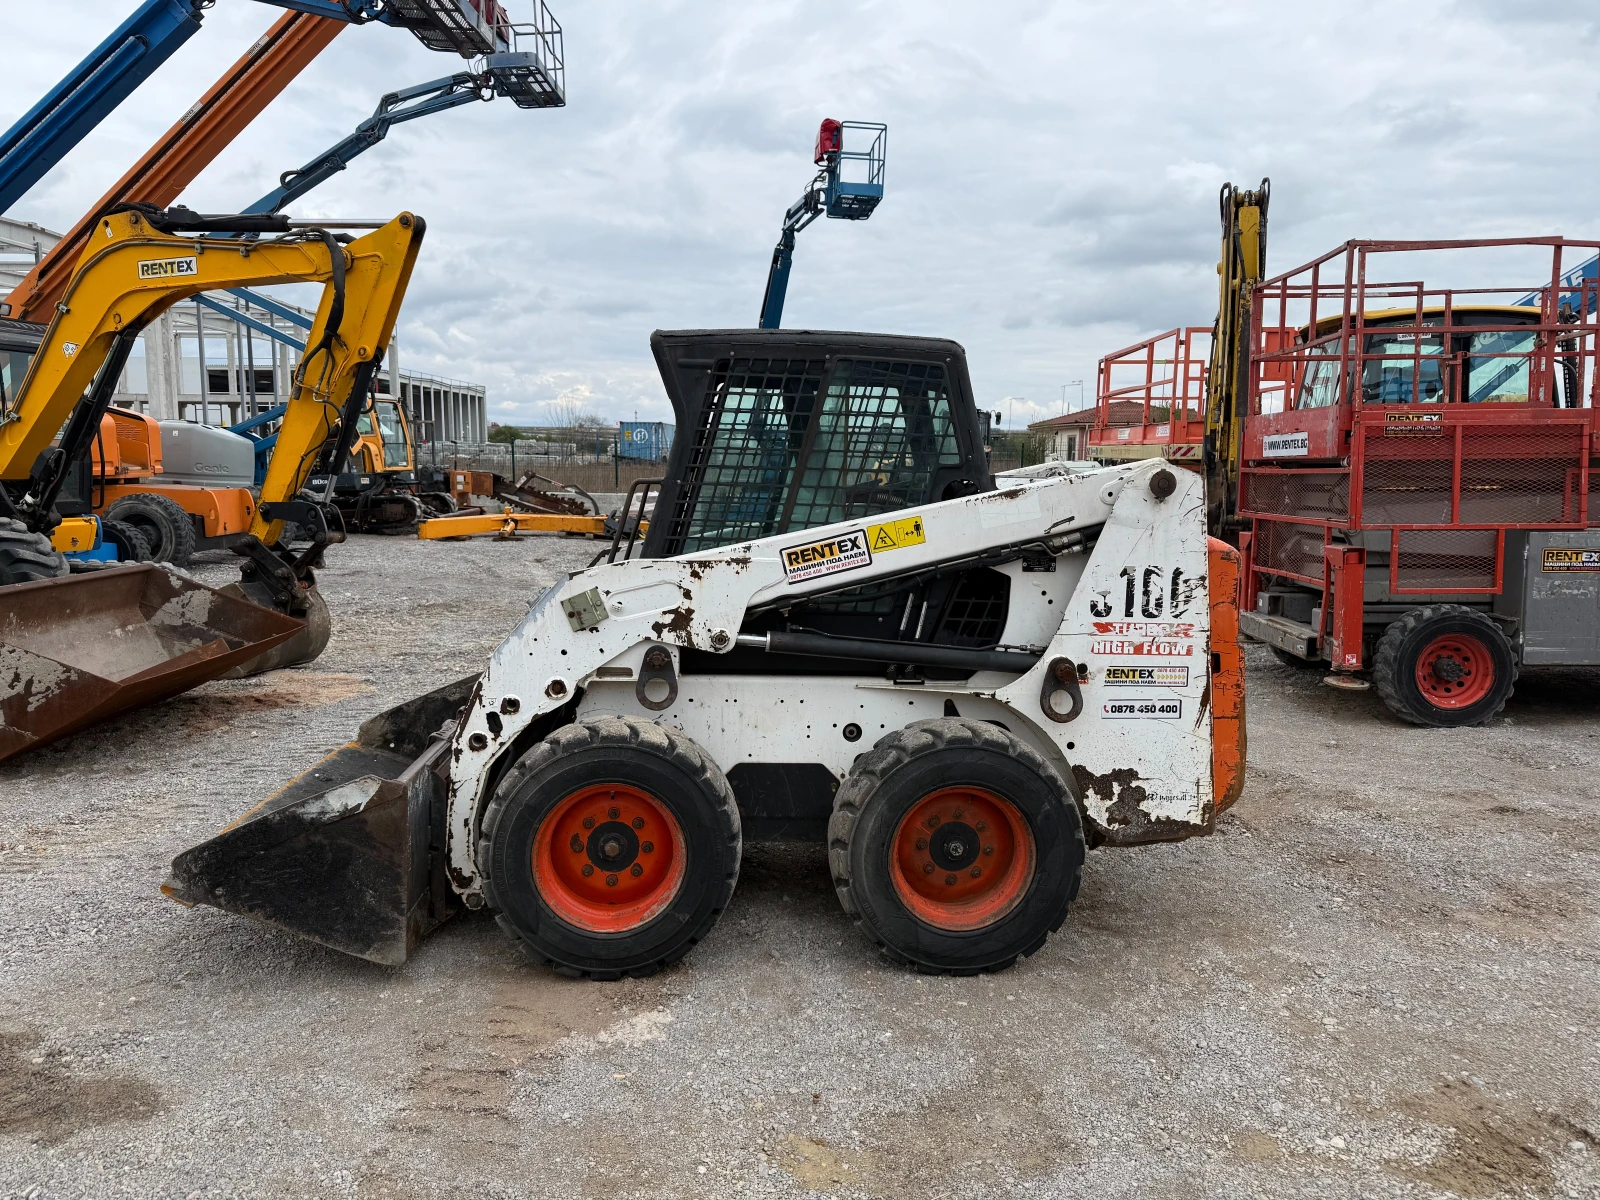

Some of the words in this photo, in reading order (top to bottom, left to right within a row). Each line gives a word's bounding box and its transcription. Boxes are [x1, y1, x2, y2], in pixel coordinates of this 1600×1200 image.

[141, 259, 194, 276] RENTEX
[193, 462, 229, 474] Genie
[787, 535, 862, 567] RENTEX
[1546, 551, 1599, 562] RENTEX
[789, 561, 826, 575] МАШИНИ
[826, 557, 843, 566] ПОД
[843, 550, 866, 561] НАЕМ
[1142, 641, 1188, 655] FLOW
[1105, 668, 1155, 680] RENTEX
[1110, 704, 1135, 714] 0878
[1137, 704, 1156, 714] 450
[1158, 705, 1178, 714] 400
